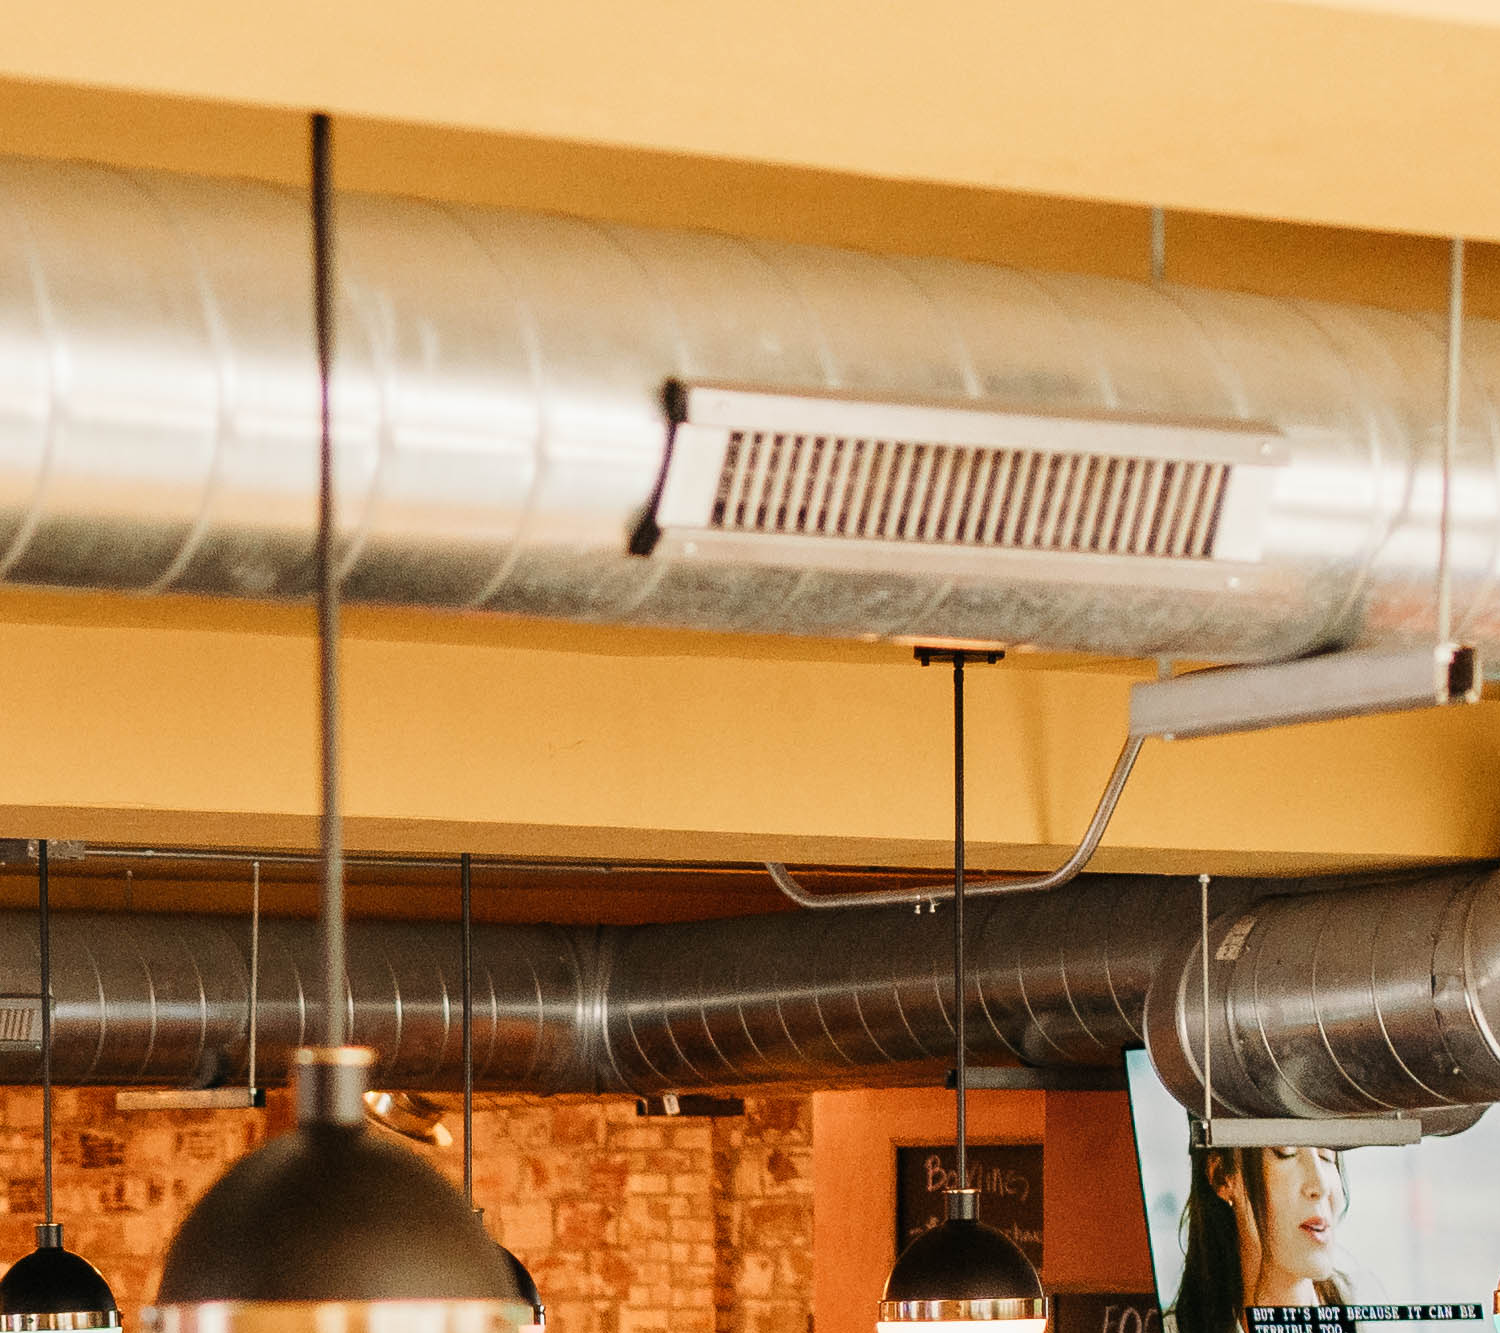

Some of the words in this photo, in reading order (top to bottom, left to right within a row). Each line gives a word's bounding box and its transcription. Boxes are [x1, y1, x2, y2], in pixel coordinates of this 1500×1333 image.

[1253, 1307, 1275, 1322] BUT
[1282, 1307, 1311, 1321] IT'S
[1317, 1306, 1341, 1321] NOT
[1347, 1305, 1400, 1320] BECAUSE
[1407, 1305, 1422, 1319] IT
[1429, 1304, 1453, 1319] CAN
[1459, 1304, 1477, 1319] BE
